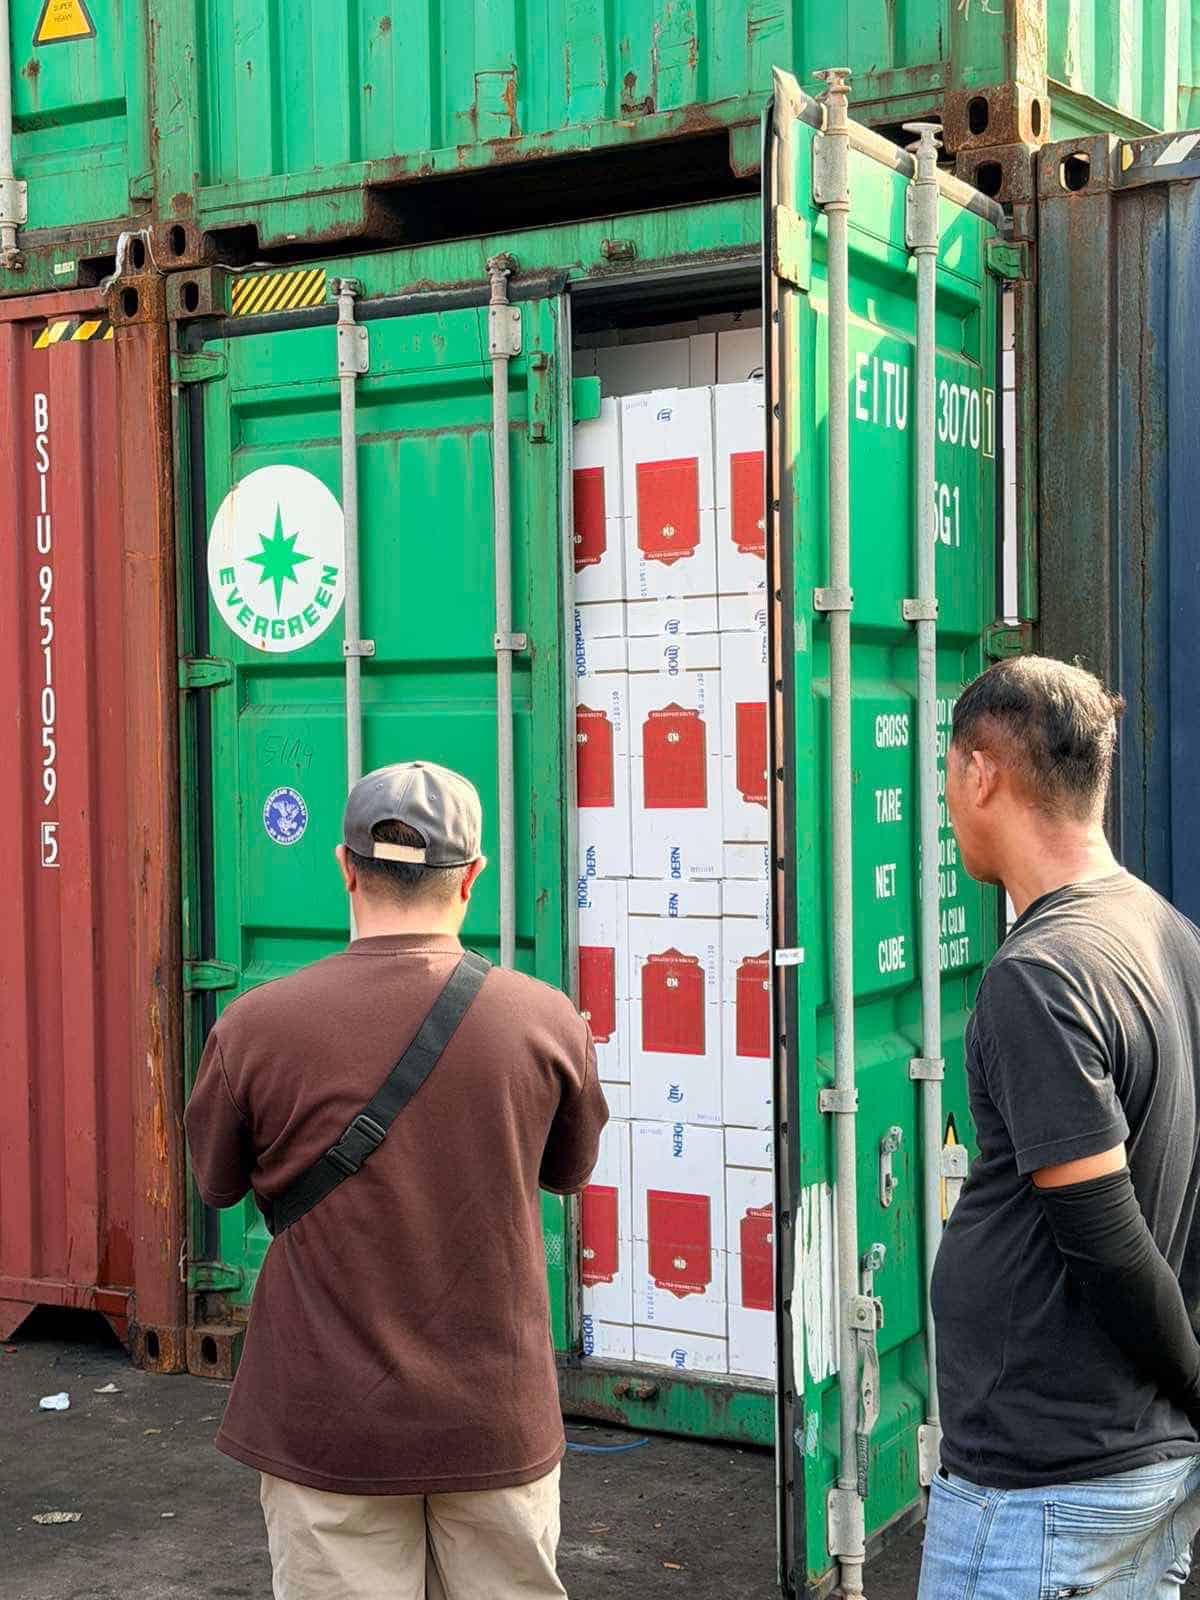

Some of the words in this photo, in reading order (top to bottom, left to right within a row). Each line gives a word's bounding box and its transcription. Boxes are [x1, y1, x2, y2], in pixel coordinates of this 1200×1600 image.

[855, 352, 908, 431] EITU
[937, 379, 980, 450] 3070
[34, 393, 51, 554] BSIU
[218, 564, 340, 640] EVERGREEN
[39, 565, 56, 805] 951059
[874, 712, 909, 749] GROSS
[874, 787, 903, 825] TARE
[42, 823, 59, 866] 5
[874, 862, 897, 900] NET
[878, 935, 906, 974] CUBE
